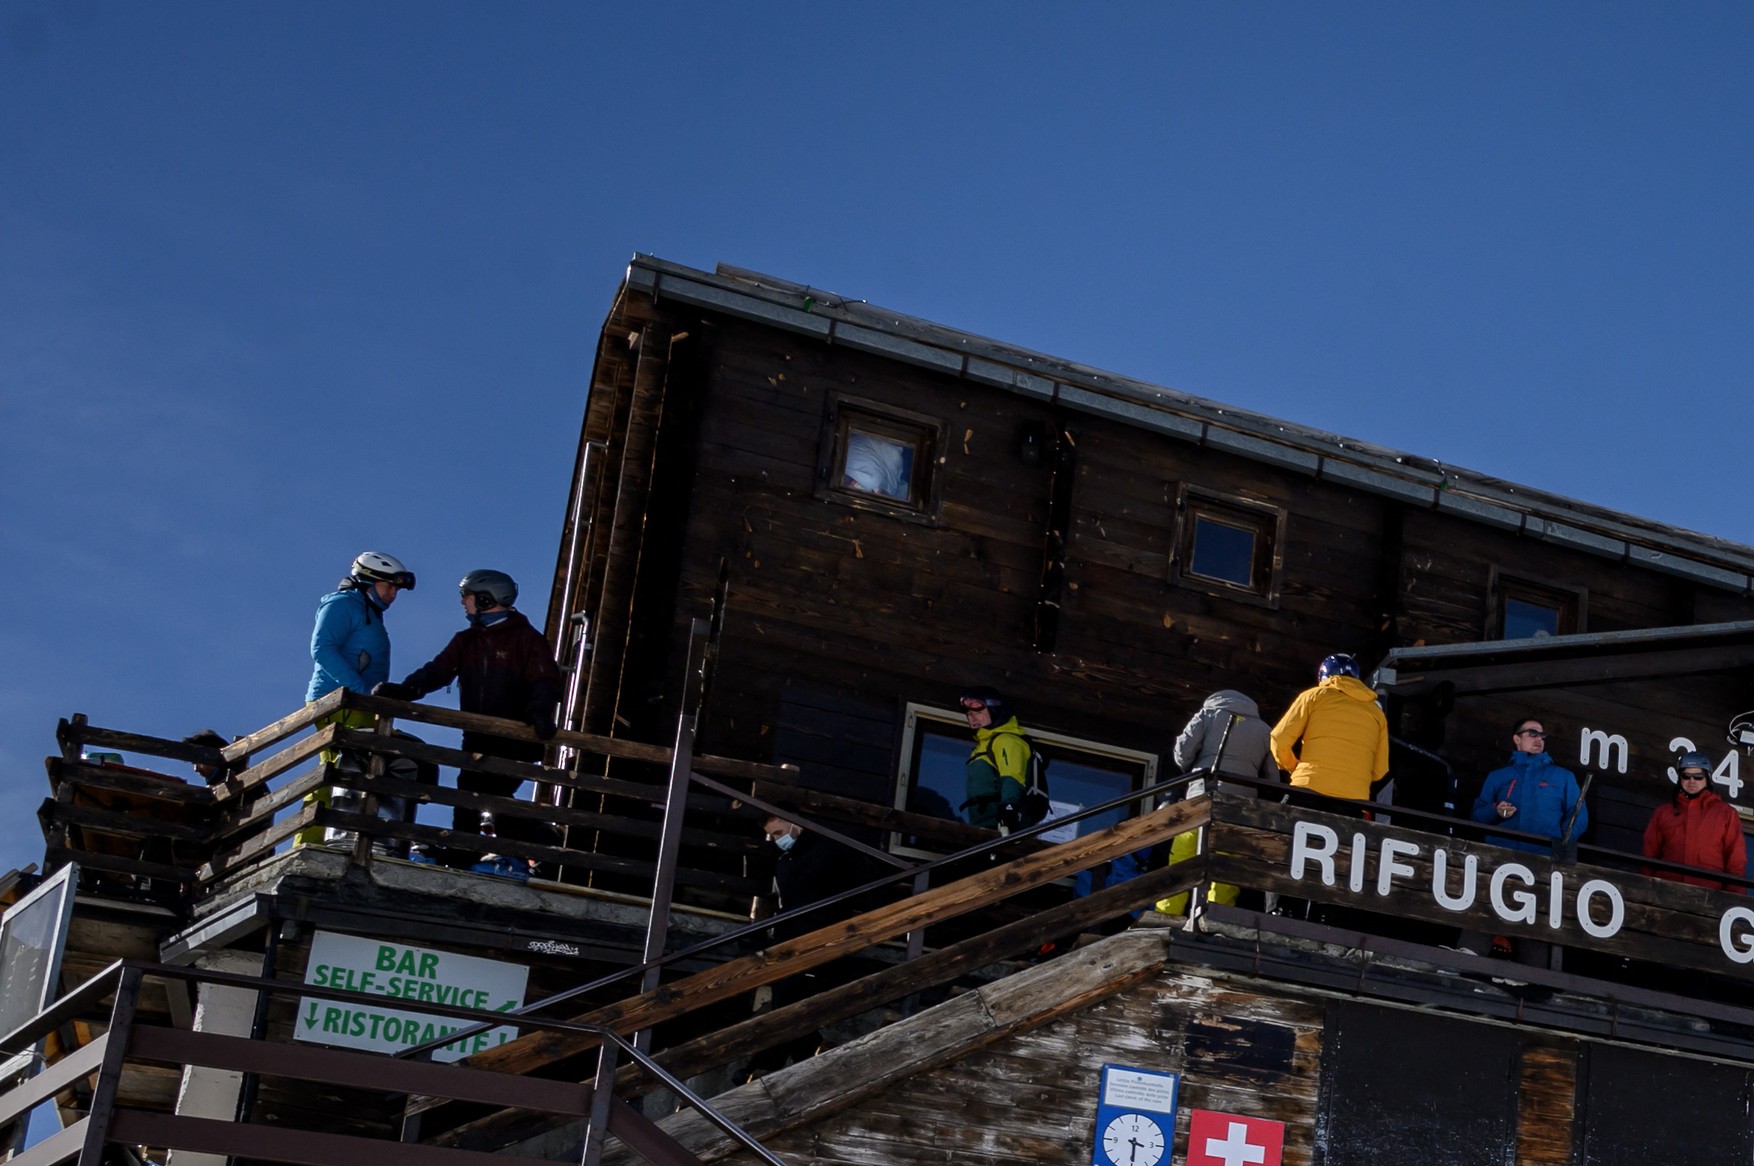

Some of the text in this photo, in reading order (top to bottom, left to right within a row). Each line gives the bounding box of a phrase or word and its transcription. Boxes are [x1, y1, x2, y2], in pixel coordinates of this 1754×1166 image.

[1579, 726, 1629, 774] m
[1290, 820, 1625, 939] RIFUGIO
[375, 945, 439, 979] BAR
[312, 964, 490, 1010] SELF-SERVICE
[1113, 1136, 1119, 1144] 9
[1131, 1125, 1139, 1133] 12
[1149, 1141, 1154, 1149] 3
